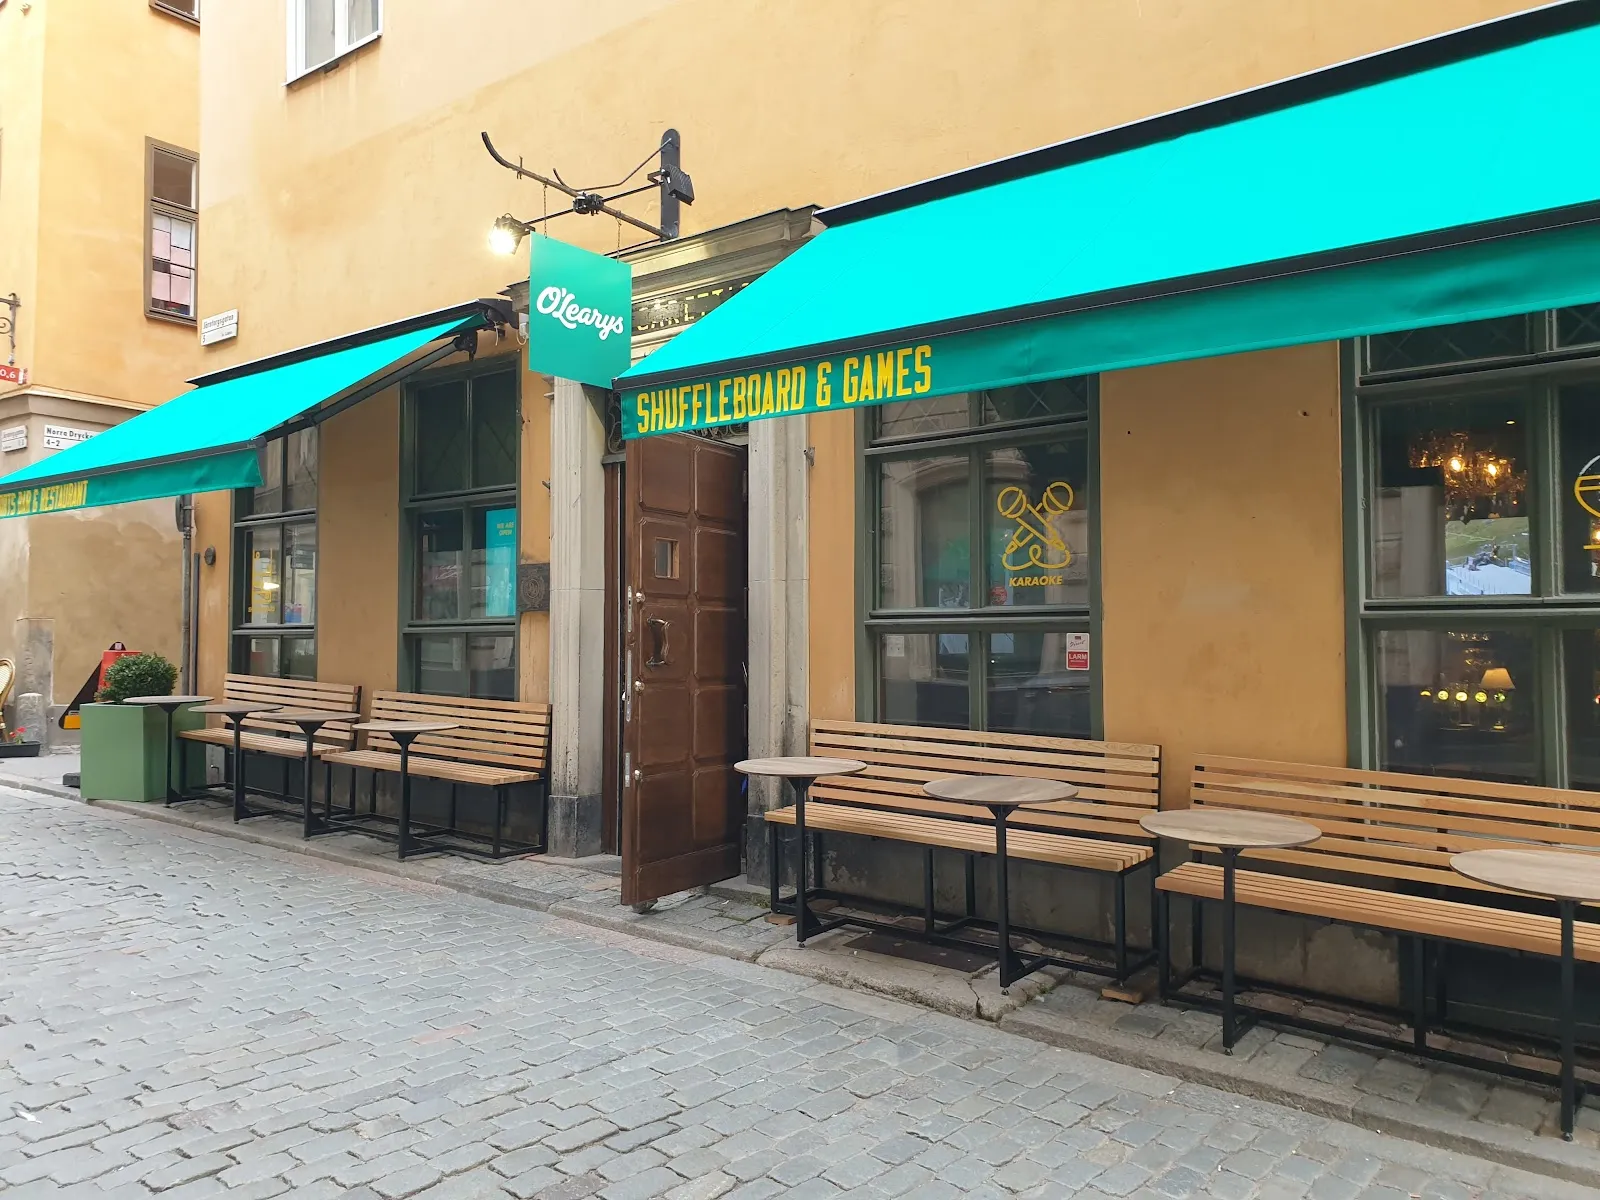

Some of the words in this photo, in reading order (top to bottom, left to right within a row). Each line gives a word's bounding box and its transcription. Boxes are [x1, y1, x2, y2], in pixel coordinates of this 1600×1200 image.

[536, 286, 625, 341] O'Learys
[636, 365, 806, 434] SHUFFLEBOARD
[815, 360, 833, 408] &
[842, 345, 933, 405] GAMES
[46, 427, 68, 437] Norra
[46, 438, 61, 447] 4-2
[40, 481, 88, 511] RESTAURANT
[1009, 575, 1062, 586] KARAOKE
